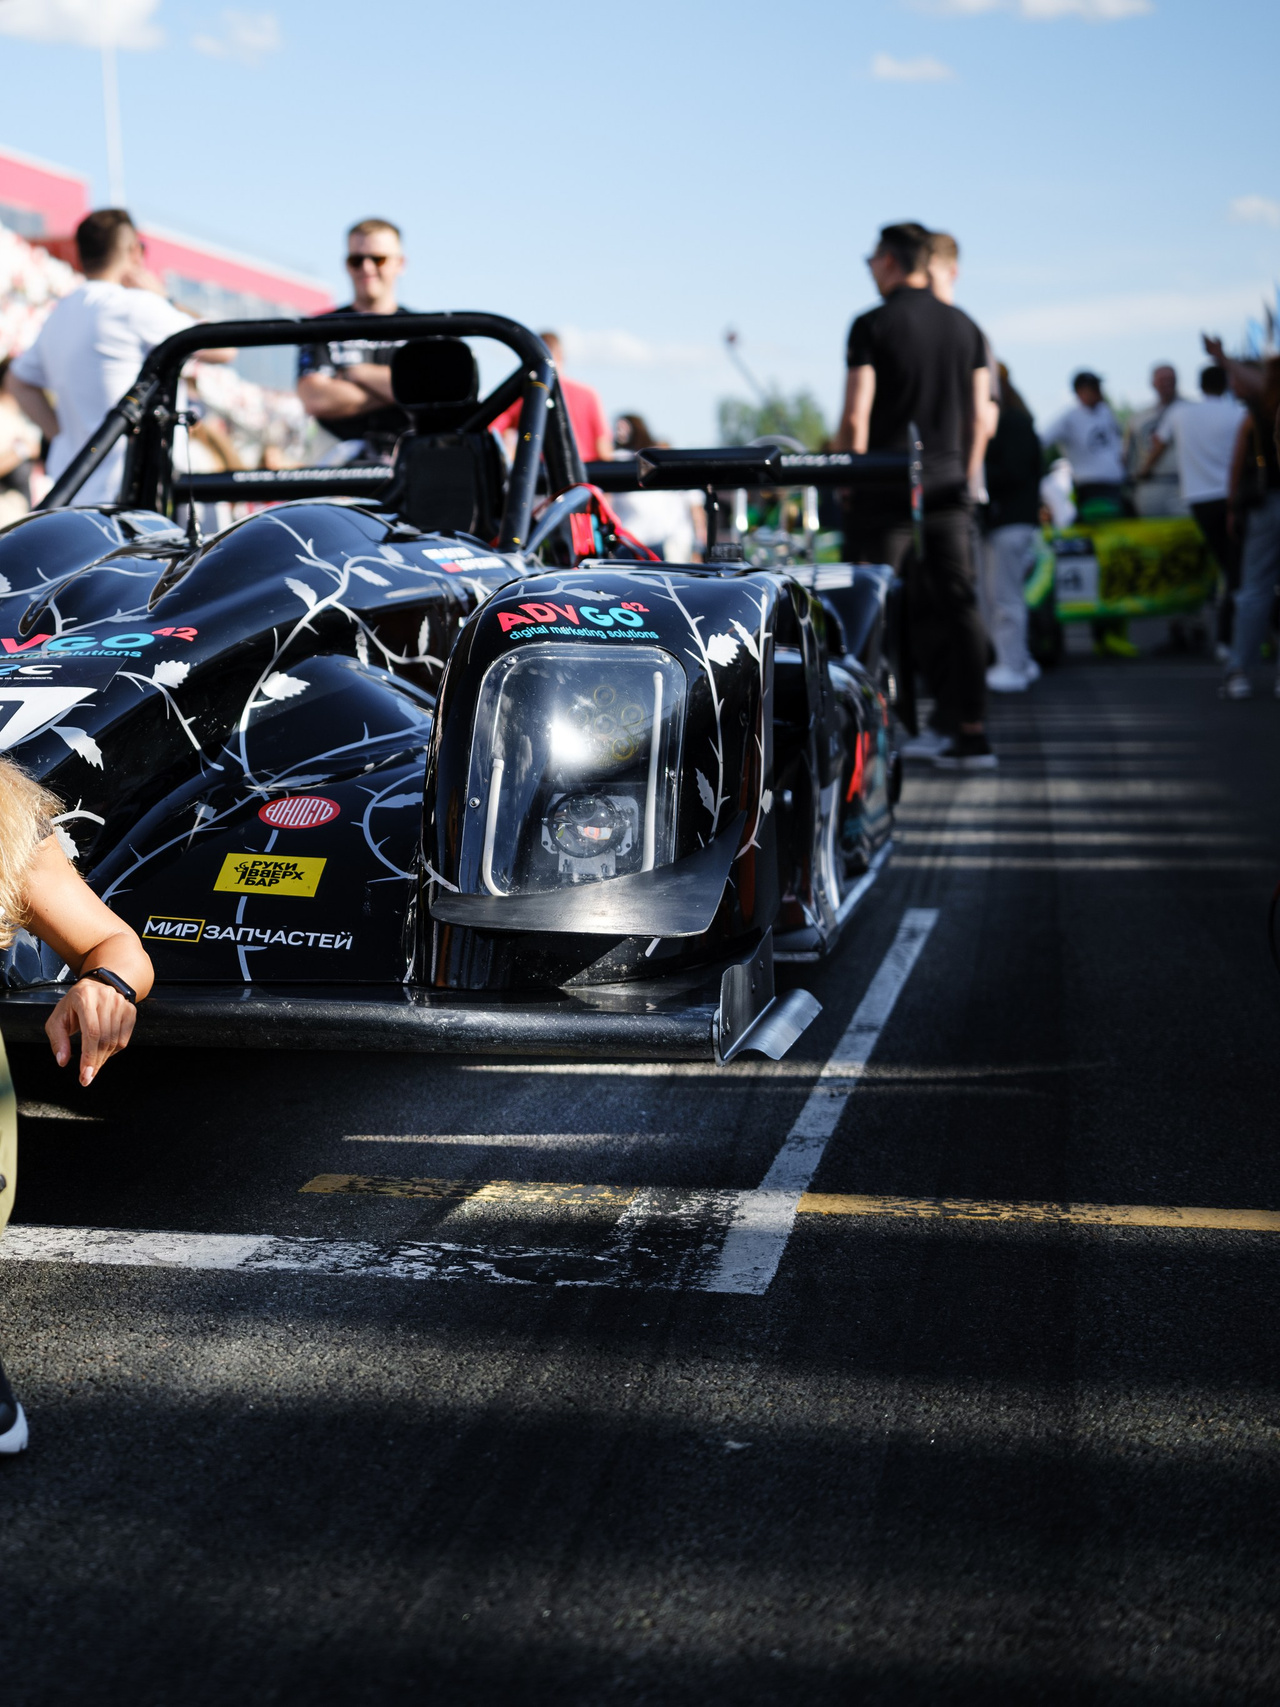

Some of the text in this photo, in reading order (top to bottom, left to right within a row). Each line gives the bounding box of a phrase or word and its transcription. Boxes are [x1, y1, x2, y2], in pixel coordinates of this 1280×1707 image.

[509, 625, 660, 640] digital marketing solutions
[265, 797, 334, 827] ЮНОСТЬ
[250, 860, 299, 871] РУКИ
[243, 876, 281, 888] БАР
[144, 920, 353, 950] МИР ЗАПЧАСТЕЙ
